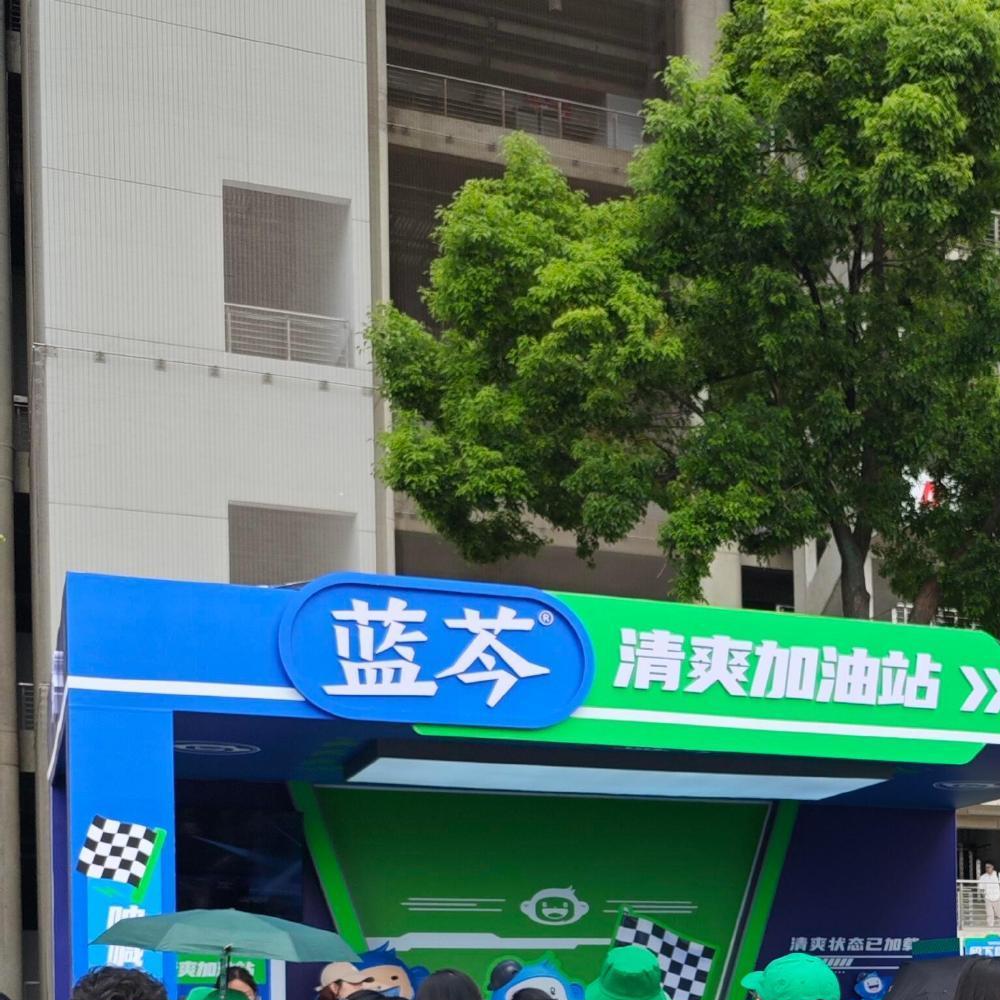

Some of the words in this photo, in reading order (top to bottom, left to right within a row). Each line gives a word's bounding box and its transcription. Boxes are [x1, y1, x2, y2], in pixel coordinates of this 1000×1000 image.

[613, 628, 942, 709] 清爽加油站
